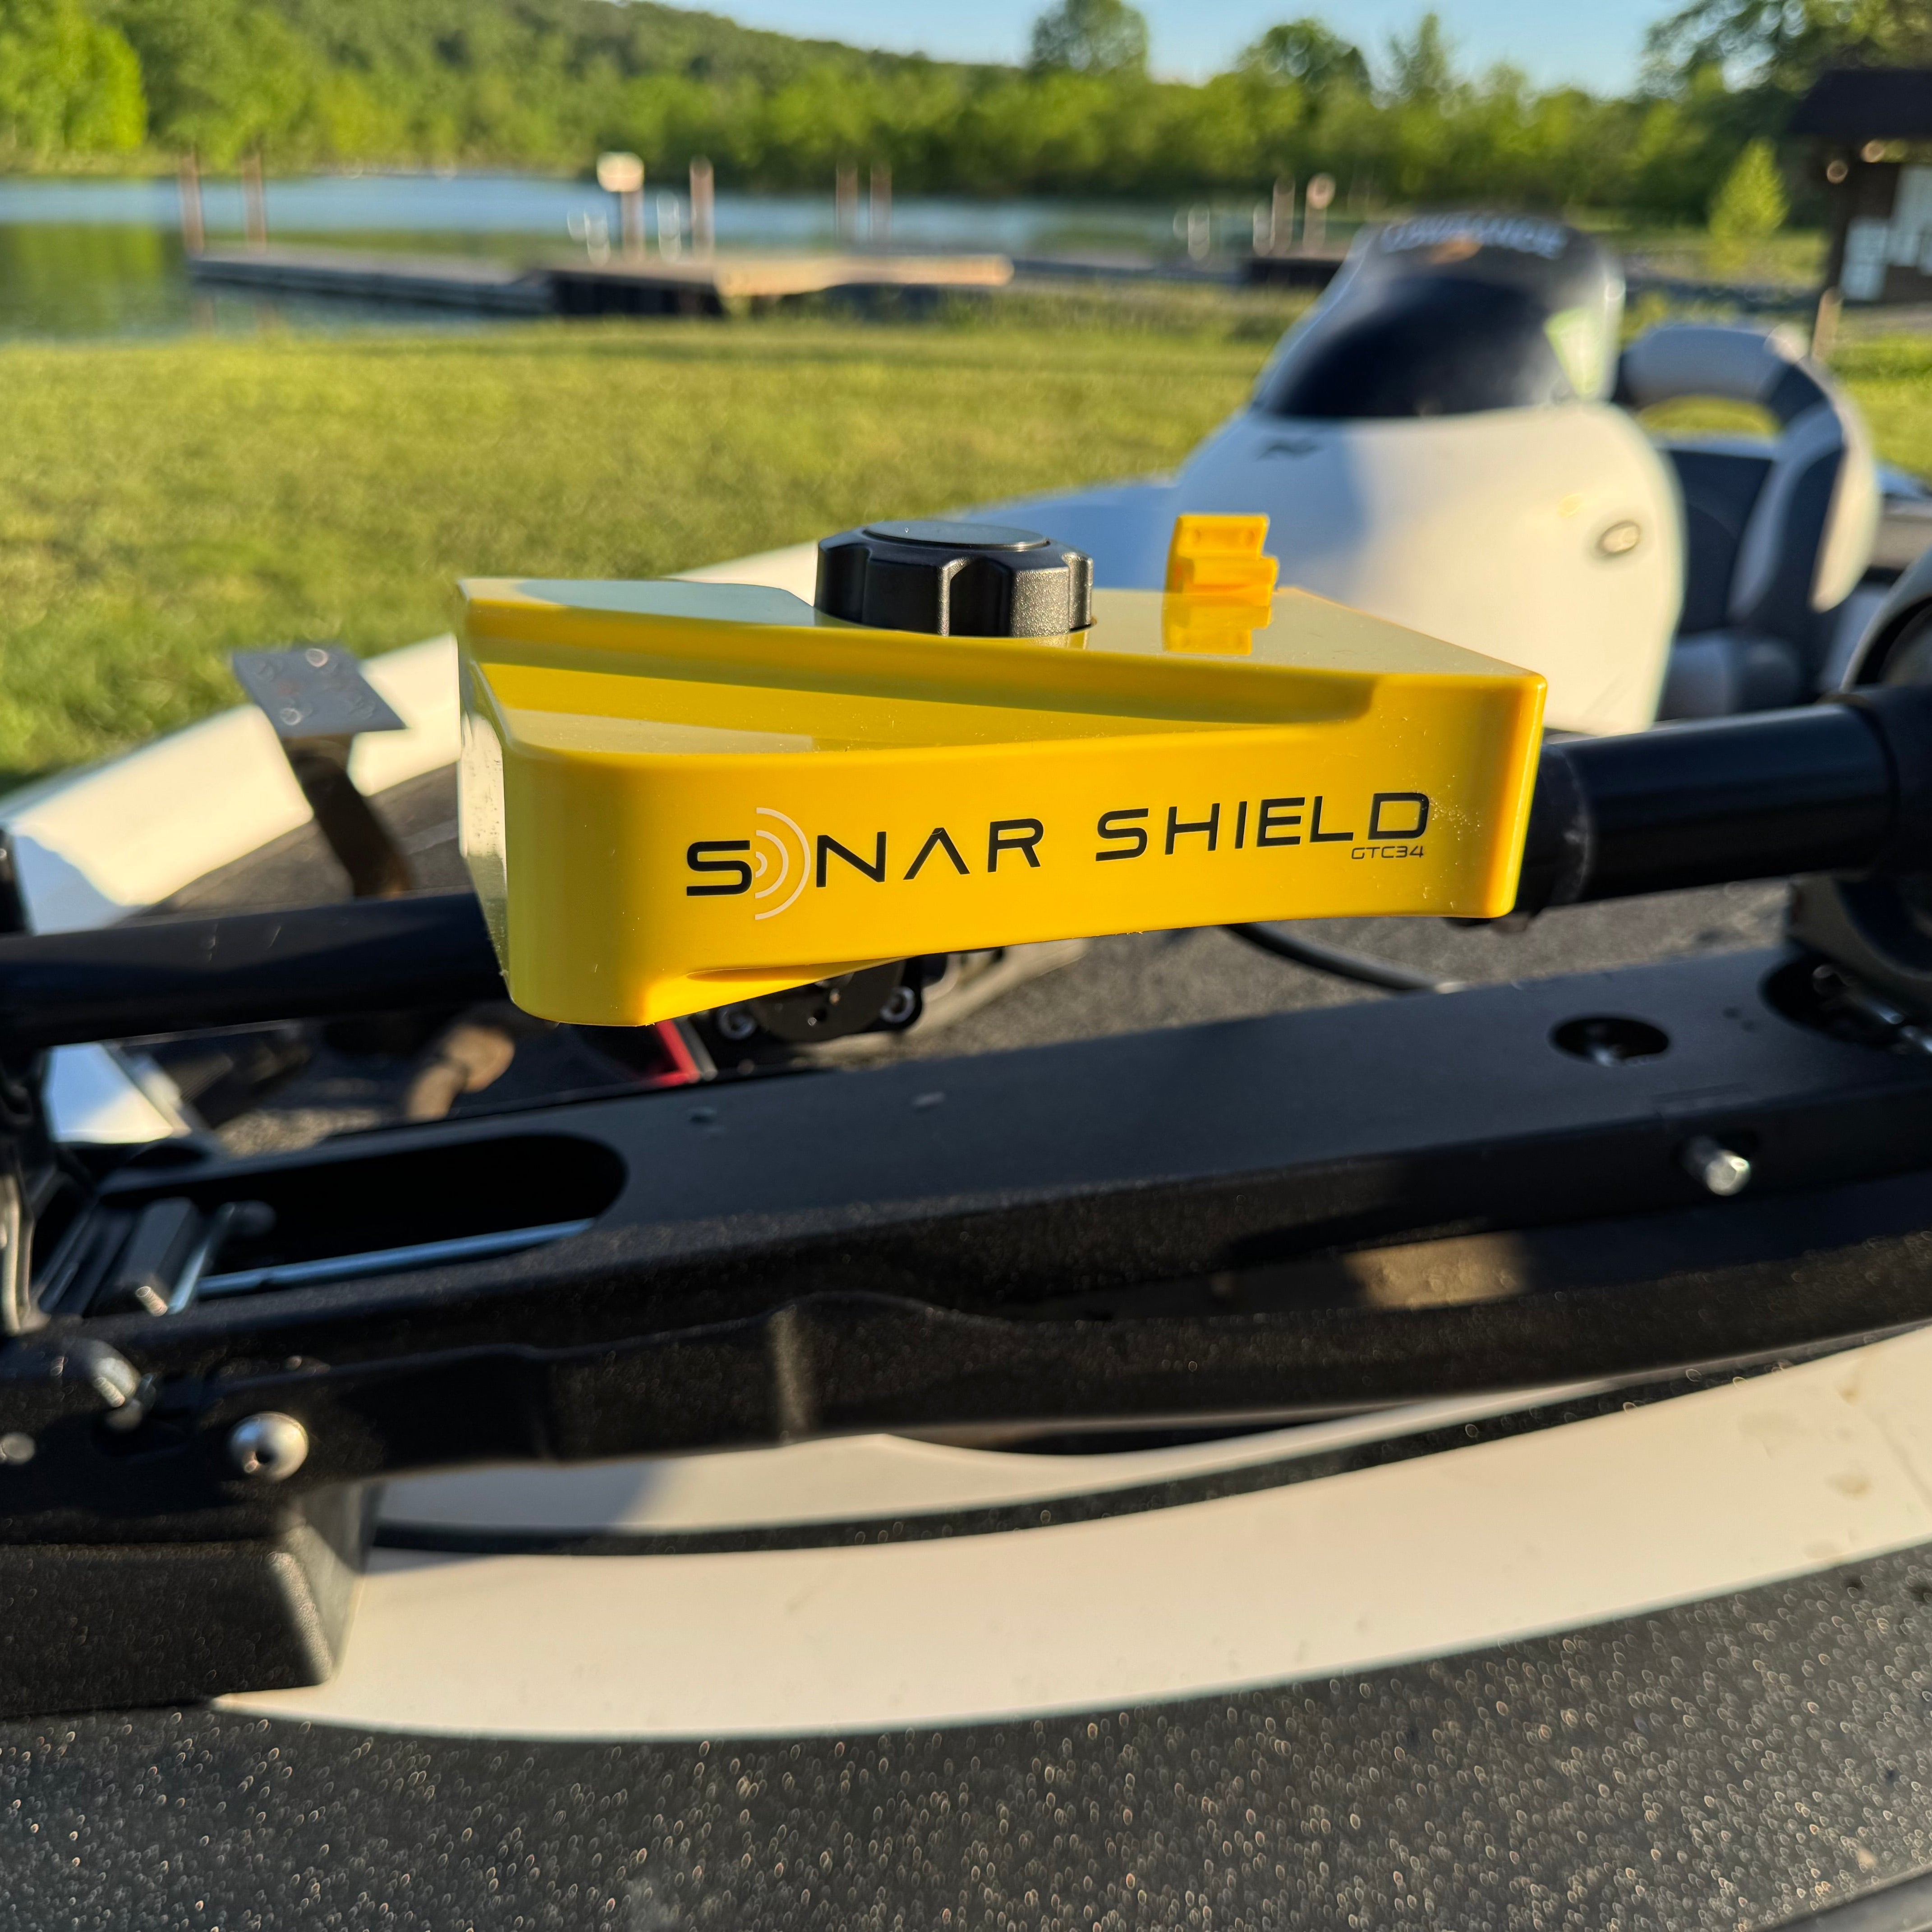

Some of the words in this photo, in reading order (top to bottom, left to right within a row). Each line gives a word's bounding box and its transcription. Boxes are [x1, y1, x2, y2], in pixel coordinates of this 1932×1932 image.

[685, 808, 1044, 920] SONAR
[1095, 791, 1430, 862] SHIELD
[1351, 846, 1424, 860] GTC34
